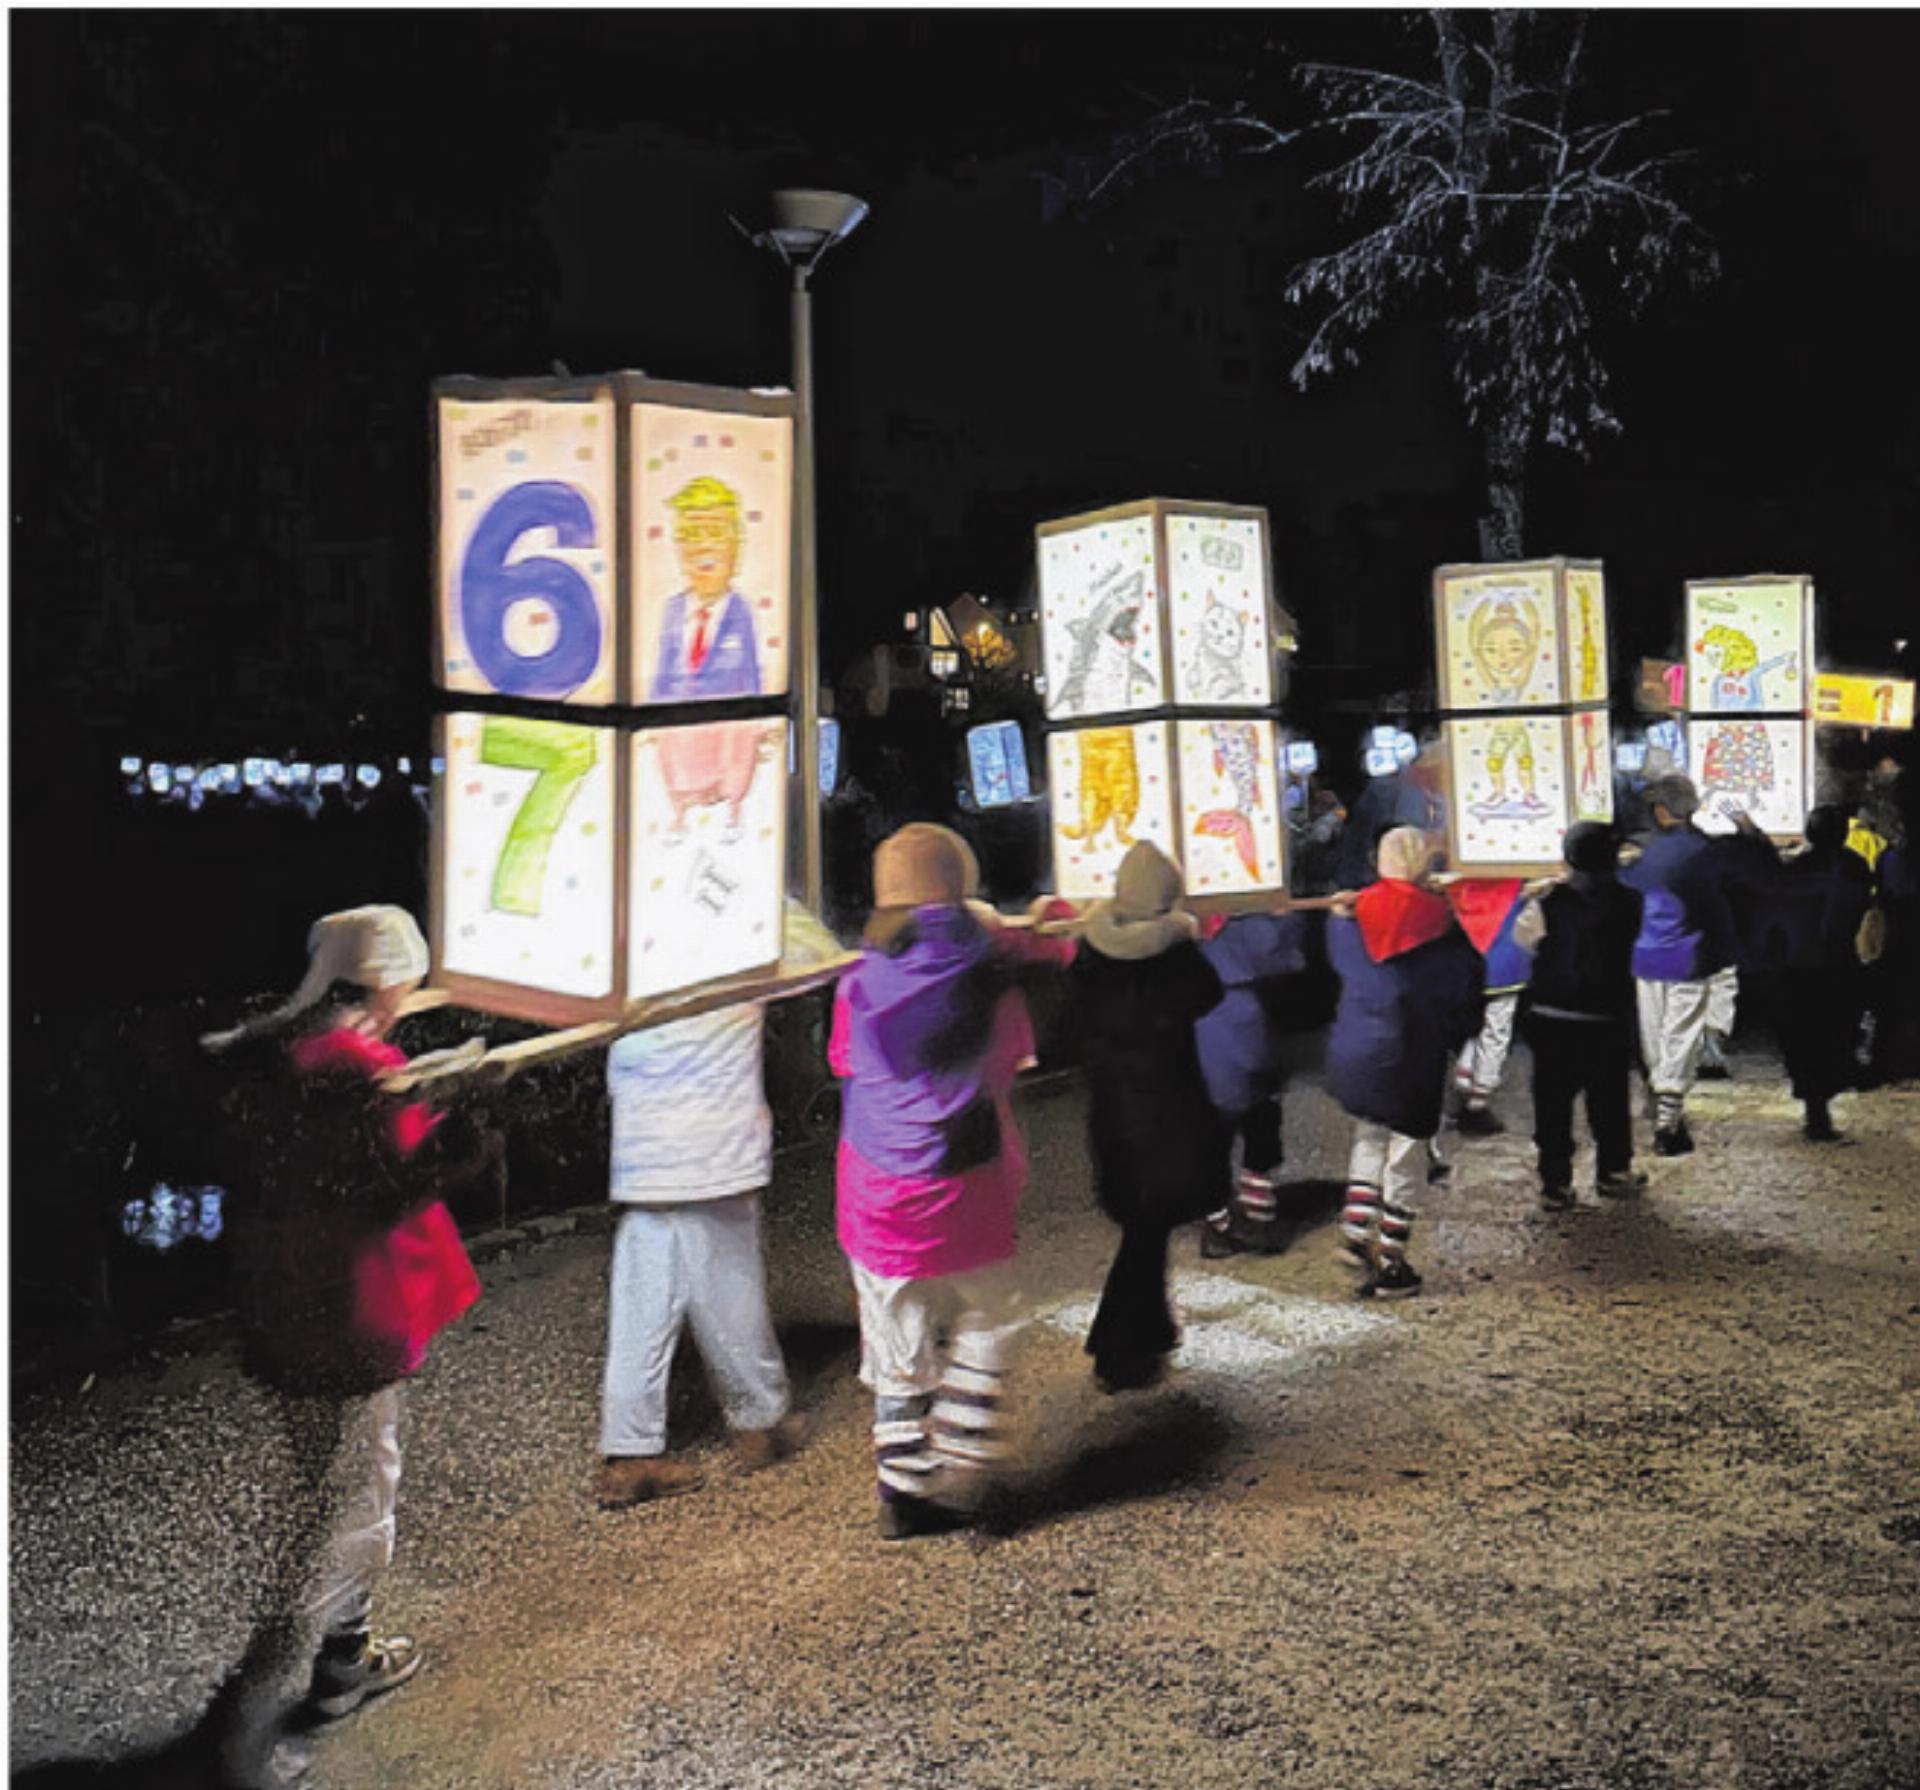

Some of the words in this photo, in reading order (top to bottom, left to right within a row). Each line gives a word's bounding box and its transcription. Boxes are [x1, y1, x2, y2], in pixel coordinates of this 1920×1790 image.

[461, 479, 601, 697] 6
[1662, 664, 1685, 706] 1
[1873, 684, 1894, 724] 1
[479, 715, 598, 918] 7
